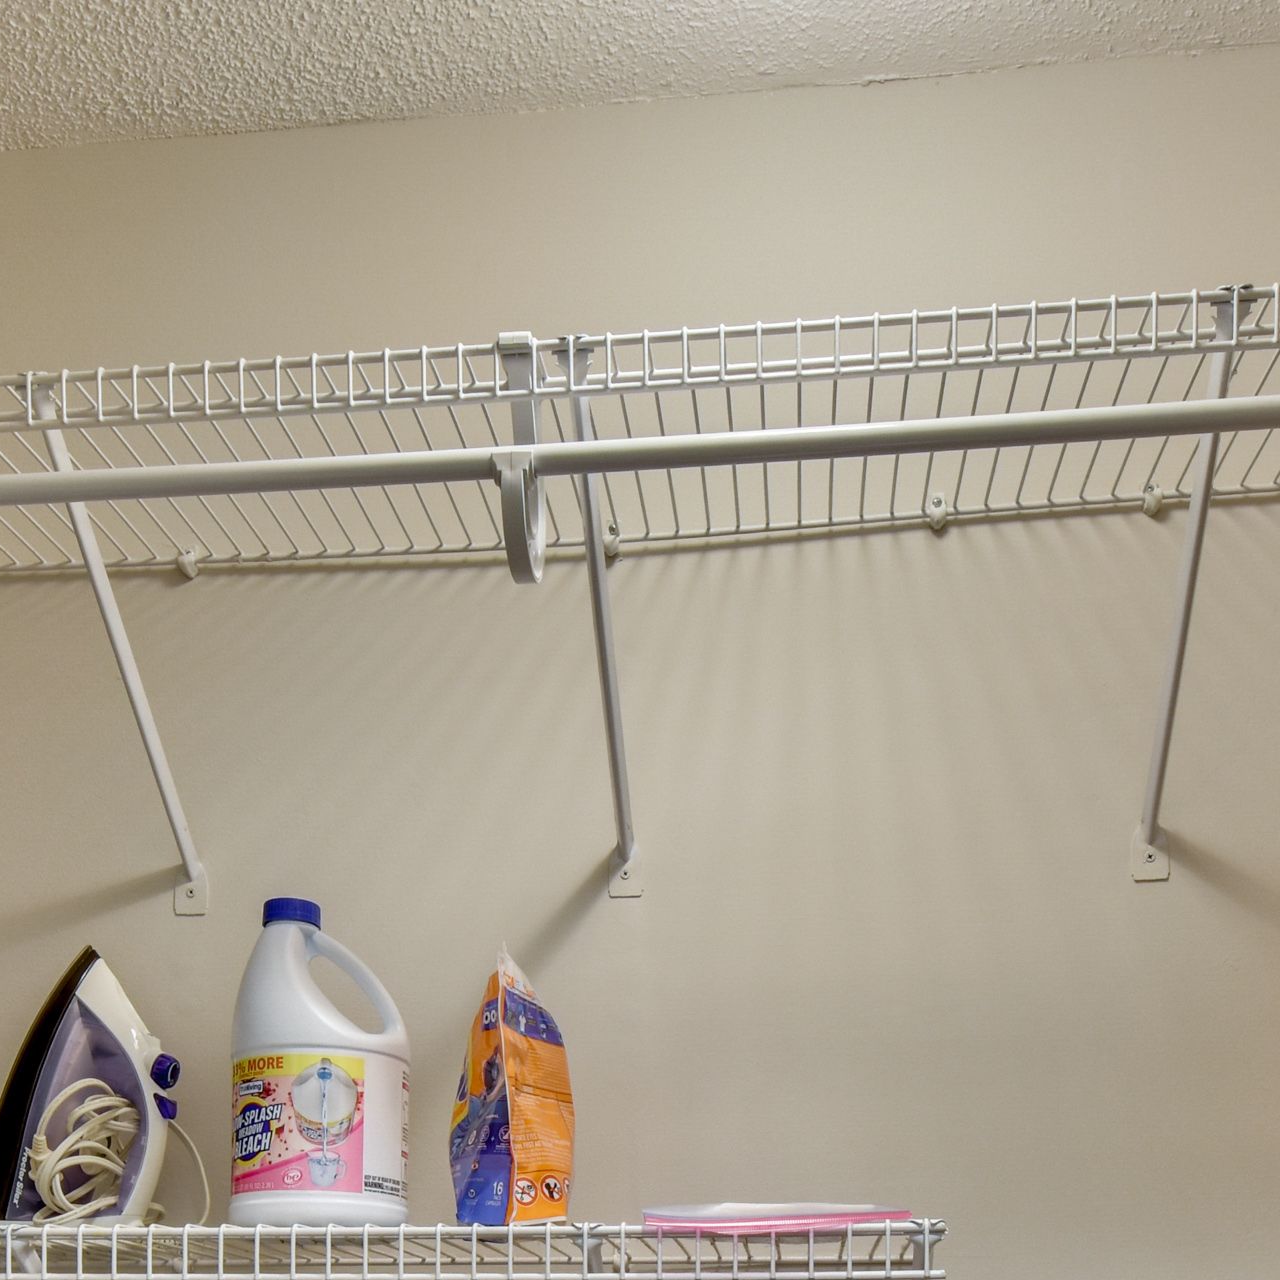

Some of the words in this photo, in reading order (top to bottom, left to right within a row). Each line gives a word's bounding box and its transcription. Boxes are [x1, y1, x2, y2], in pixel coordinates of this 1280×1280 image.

[247, 1056, 284, 1073] MORE
[18, 1146, 30, 1182] Proctor
[493, 1181, 504, 1195] 16
